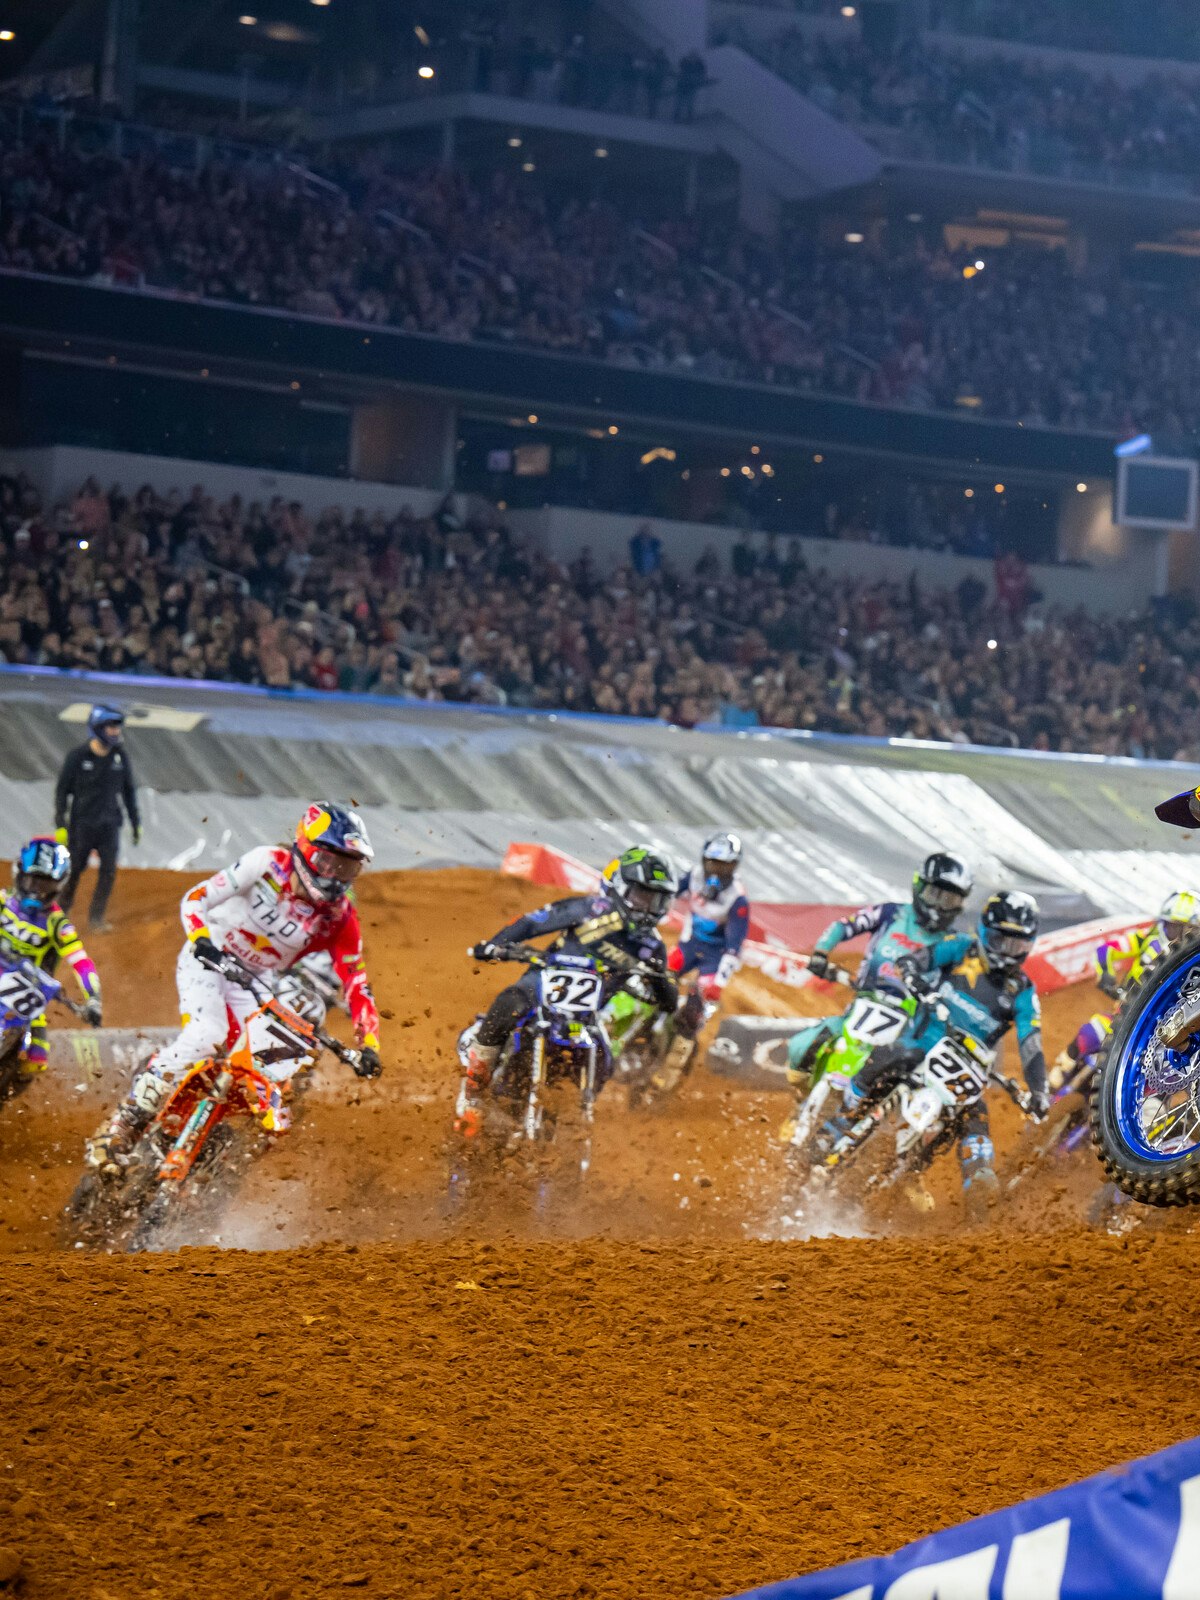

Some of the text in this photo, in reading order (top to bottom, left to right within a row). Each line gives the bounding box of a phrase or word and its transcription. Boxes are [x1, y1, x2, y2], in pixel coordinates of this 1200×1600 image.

[0, 975, 44, 1016] 78
[546, 975, 599, 1007] 32
[853, 1006, 901, 1037] 17
[252, 1024, 308, 1066] 7
[928, 1052, 982, 1097] 28
